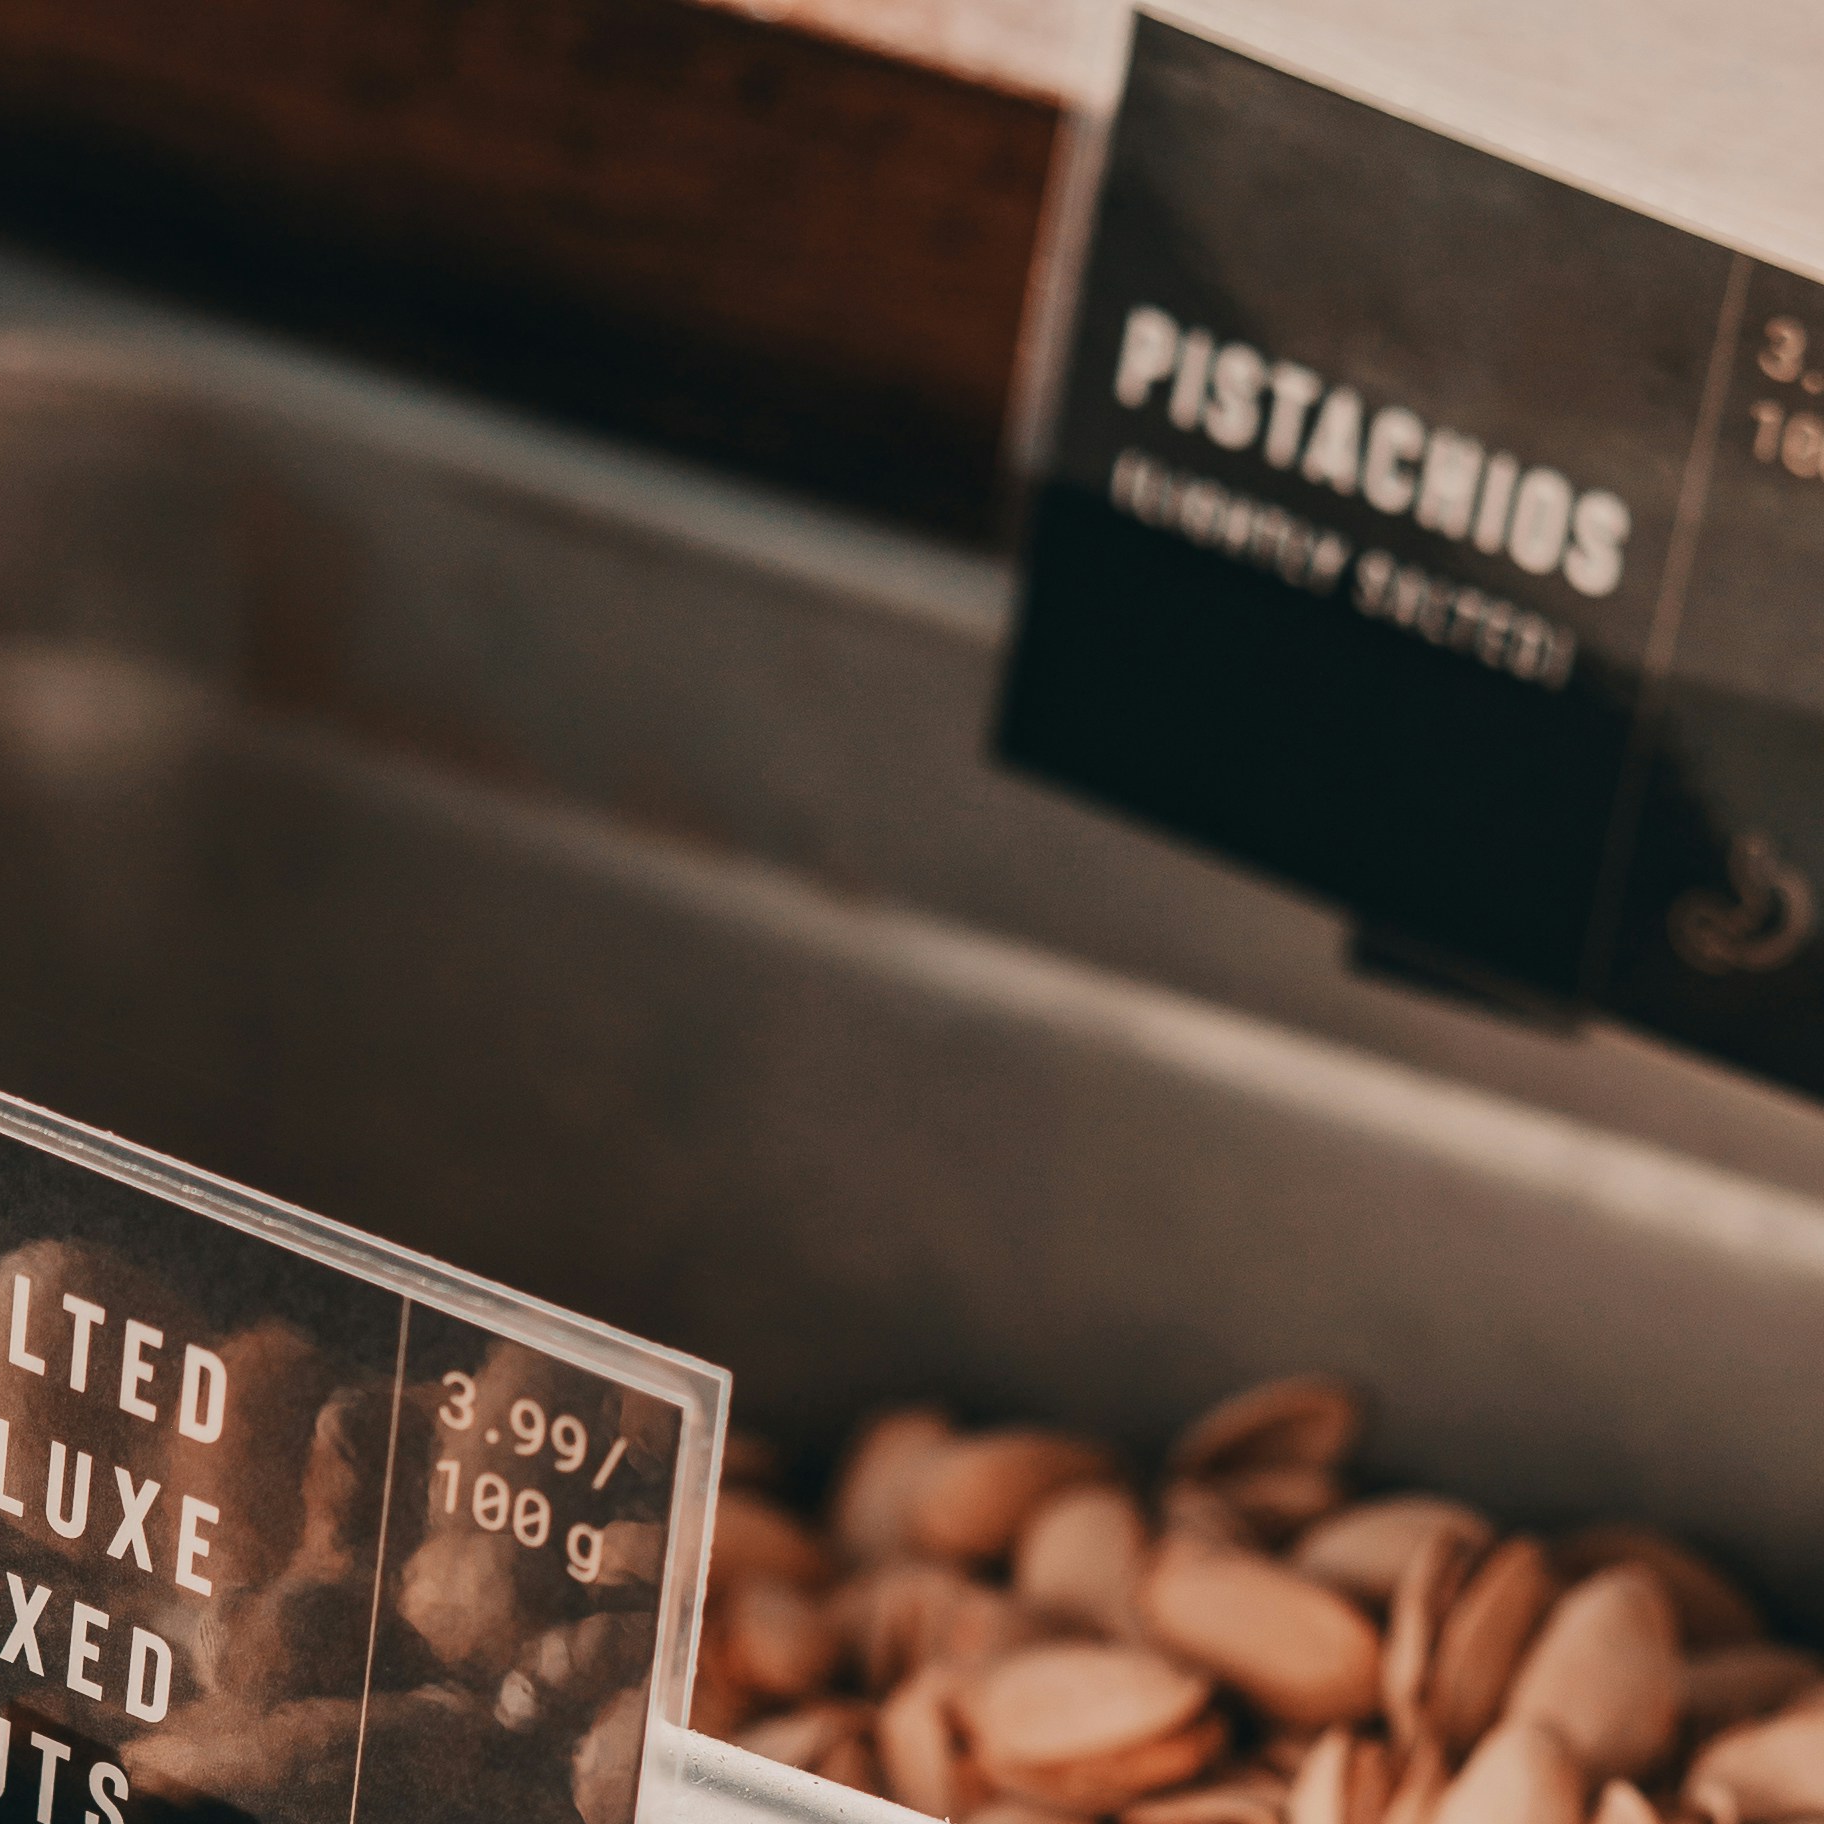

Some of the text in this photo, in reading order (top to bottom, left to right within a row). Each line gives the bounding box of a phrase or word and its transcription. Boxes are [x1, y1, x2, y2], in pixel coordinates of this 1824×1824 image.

[1114, 306, 1631, 597] PISTACHIOS
[438, 1369, 628, 1491] 3.99/
[435, 1459, 605, 1575] 100 g
